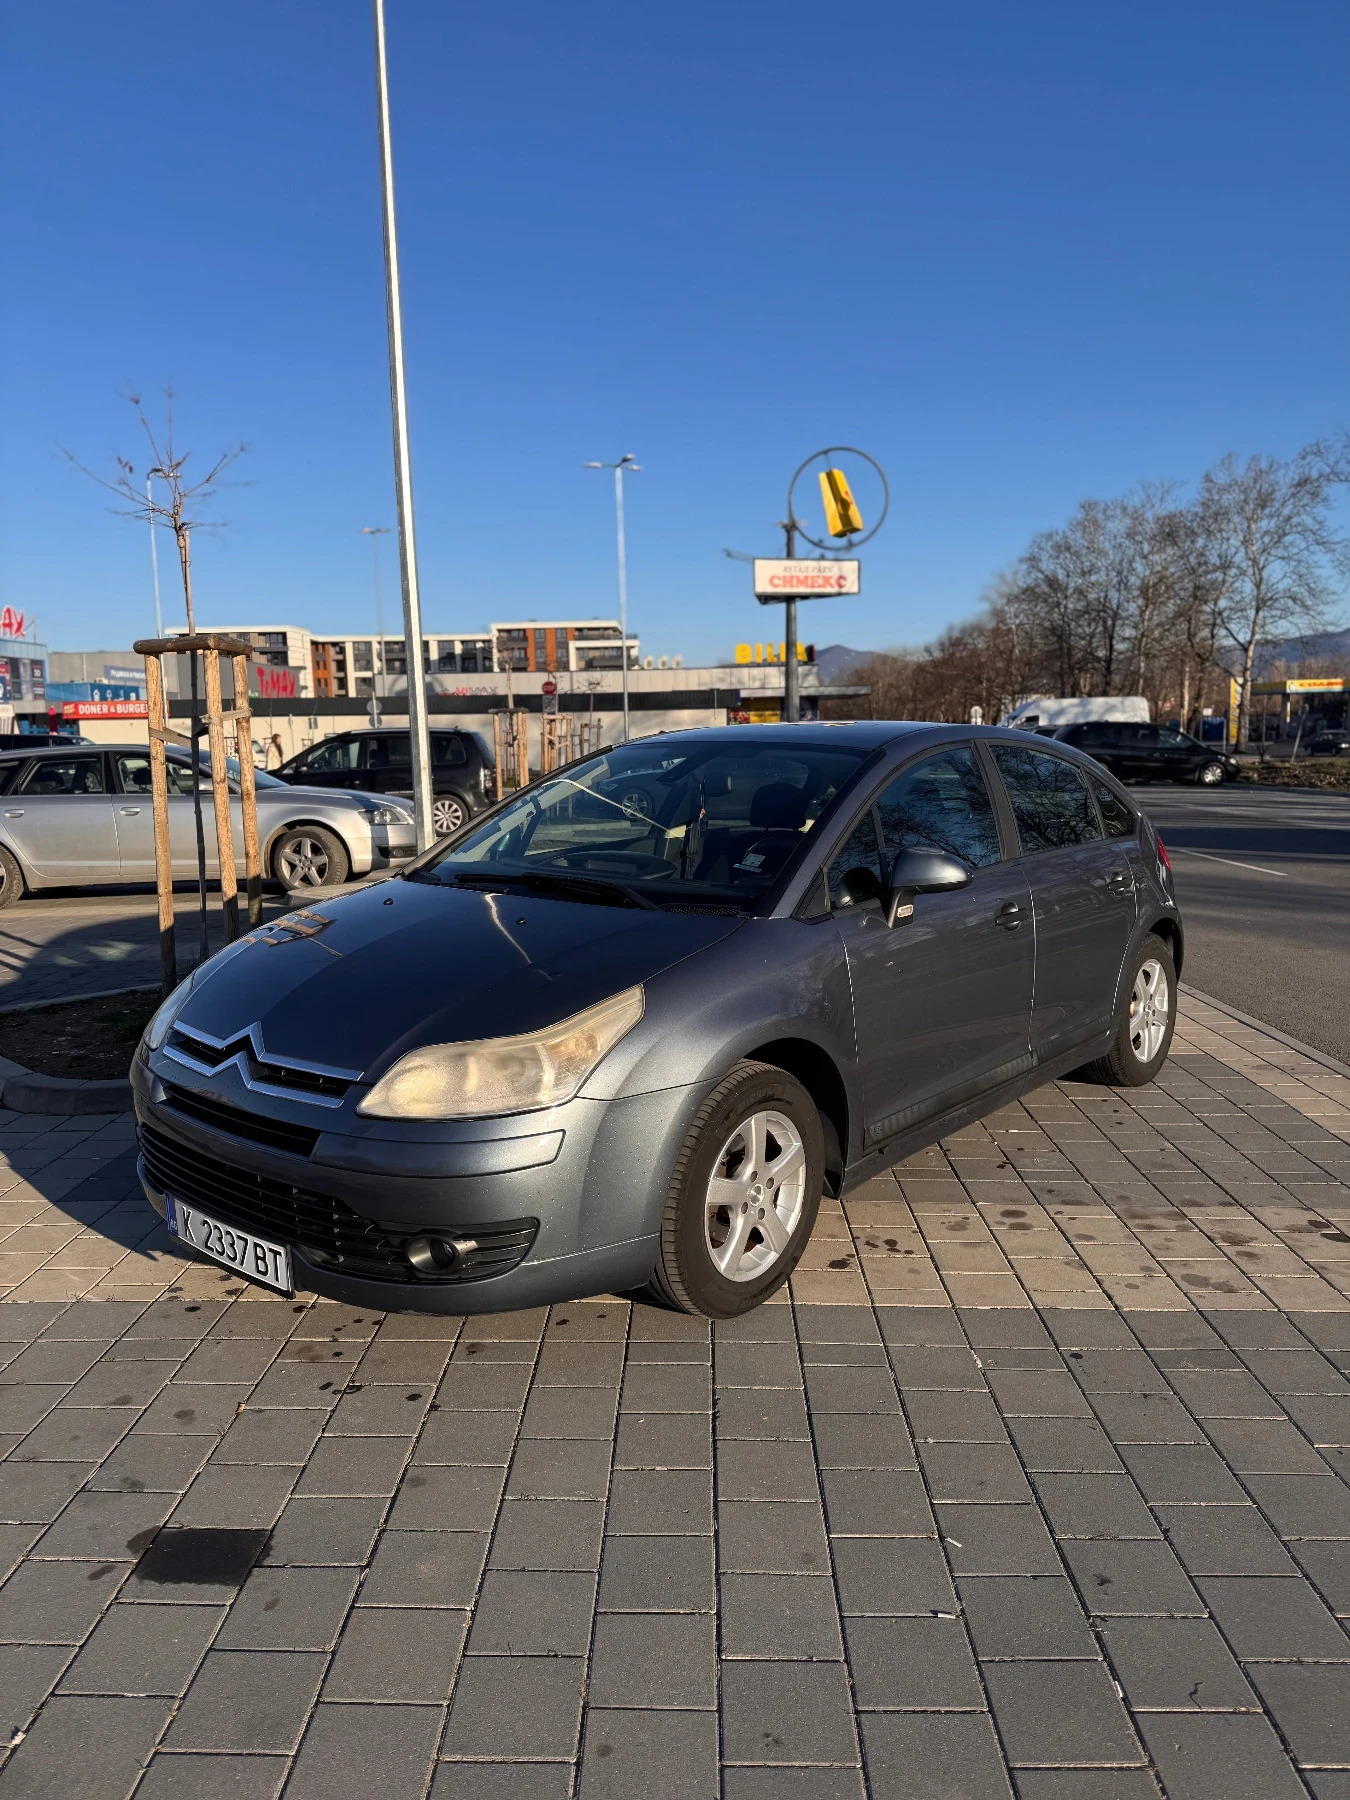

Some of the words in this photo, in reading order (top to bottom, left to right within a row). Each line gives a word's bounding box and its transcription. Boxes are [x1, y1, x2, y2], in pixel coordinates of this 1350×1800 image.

[783, 566, 809, 574] RETAIL
[811, 566, 834, 574] PARK
[79, 704, 108, 714] DONER
[110, 705, 116, 713] &
[202, 1219, 249, 1267] 2337
